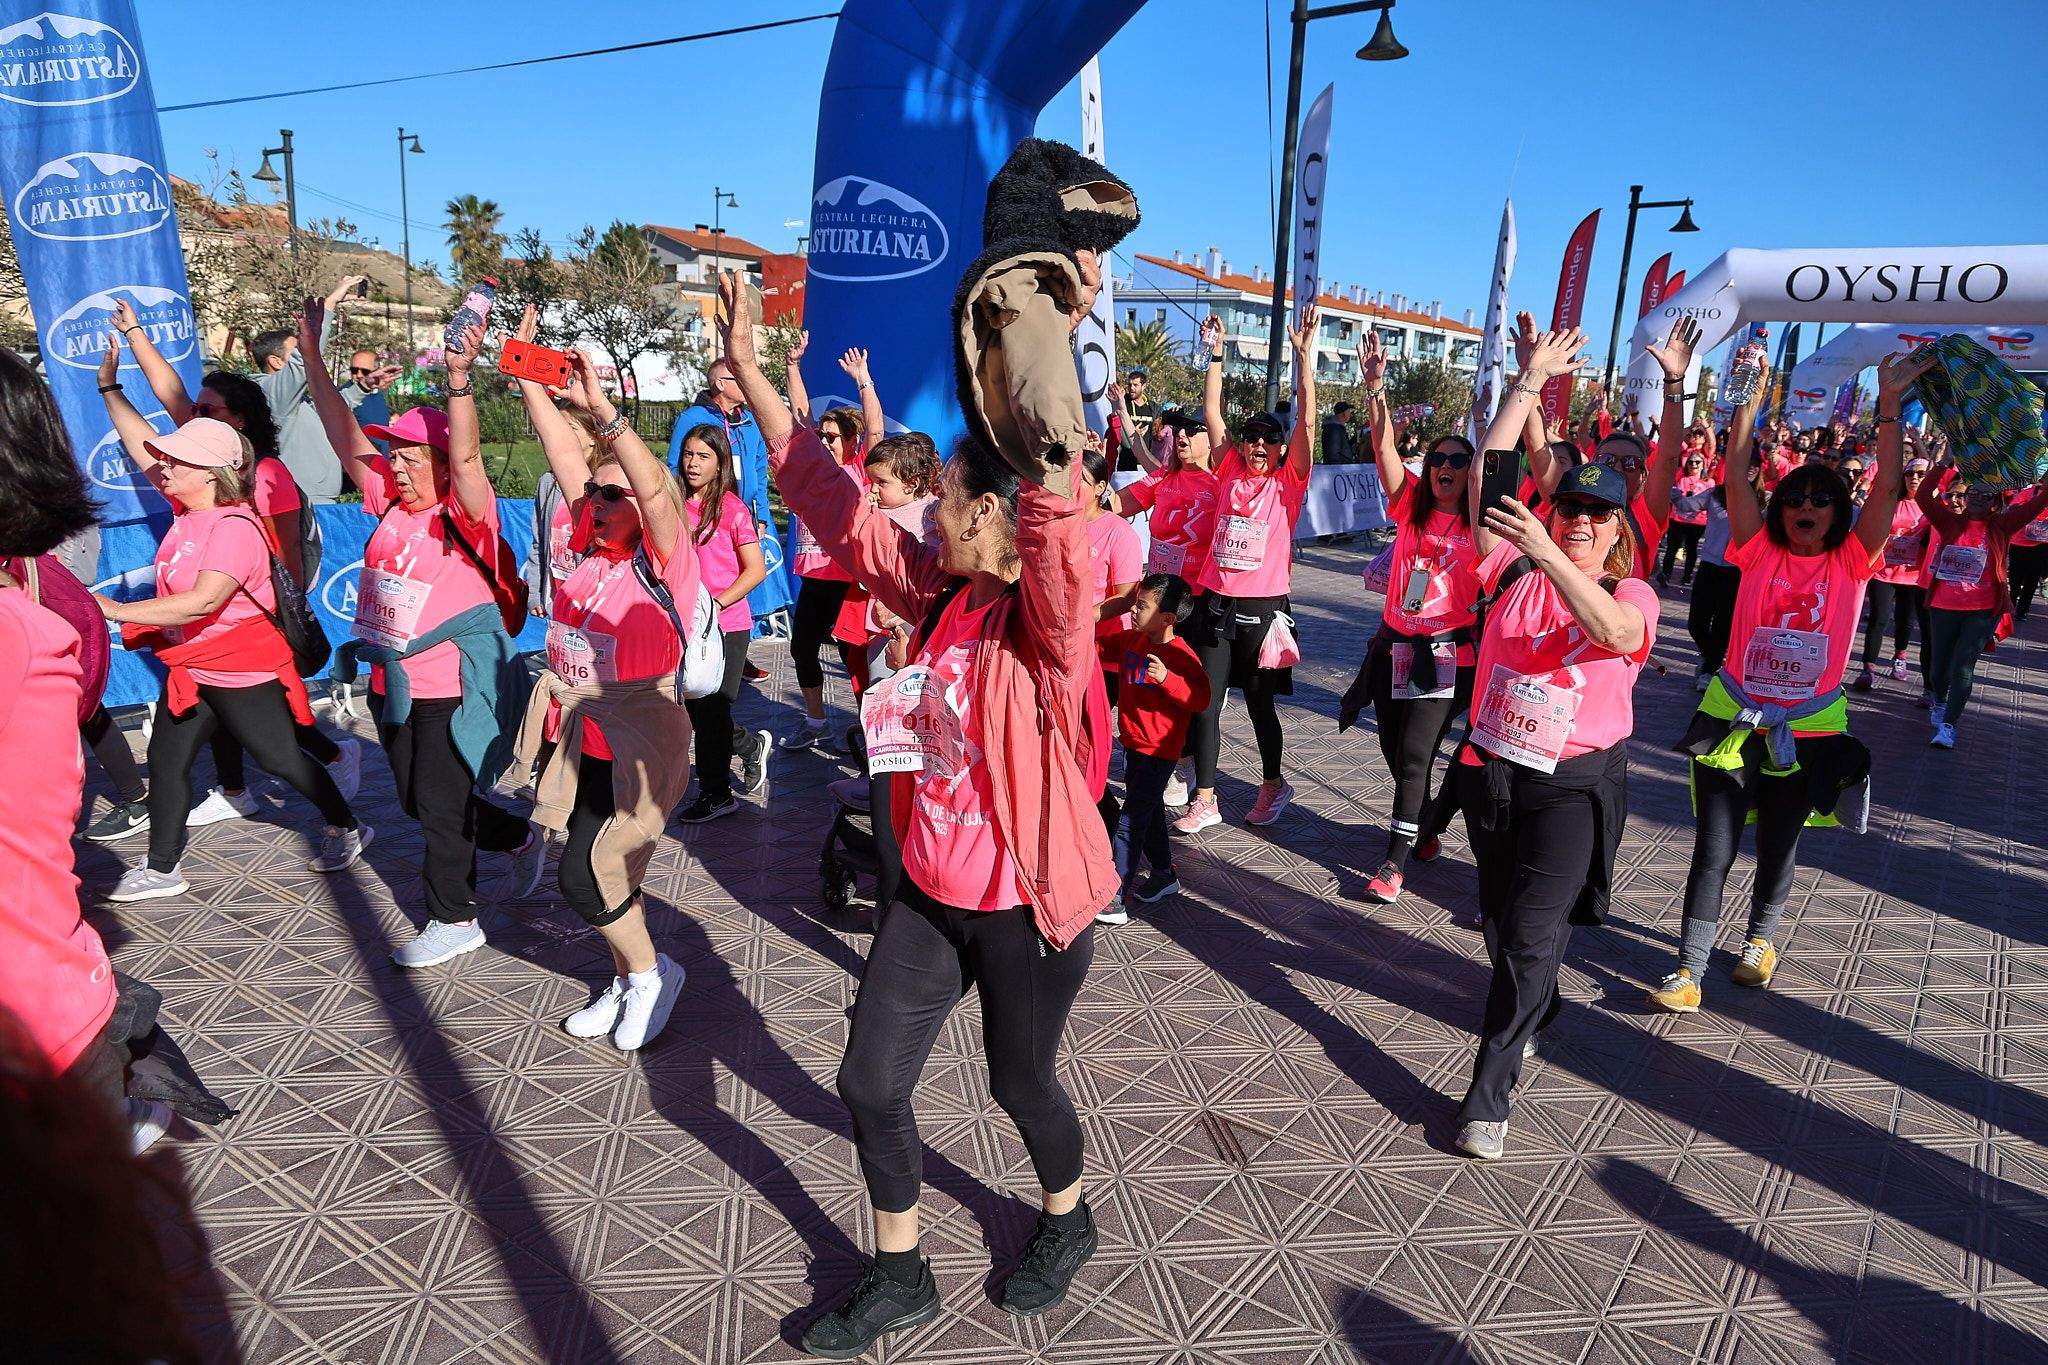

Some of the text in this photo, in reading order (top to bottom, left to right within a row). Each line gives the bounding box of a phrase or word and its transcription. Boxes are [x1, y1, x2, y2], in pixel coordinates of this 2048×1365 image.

[815, 212, 928, 229] CENTRAL LECHERA
[810, 227, 932, 261] STURIANA
[1560, 244, 1585, 331] antander
[1785, 263, 2010, 304] OYSHO
[1664, 306, 1722, 320] OYSHO
[2000, 353, 2031, 361] Energies
[1629, 378, 1665, 390] OYSH
[1226, 538, 1248, 550] 016
[374, 604, 396, 619] 016
[562, 661, 589, 679] 016
[1769, 659, 1801, 673] 016
[902, 713, 942, 736] 016
[1504, 710, 1538, 733] 016
[912, 735, 935, 744] 1277
[872, 756, 912, 768] OYSHO
[931, 804, 945, 821] DE
